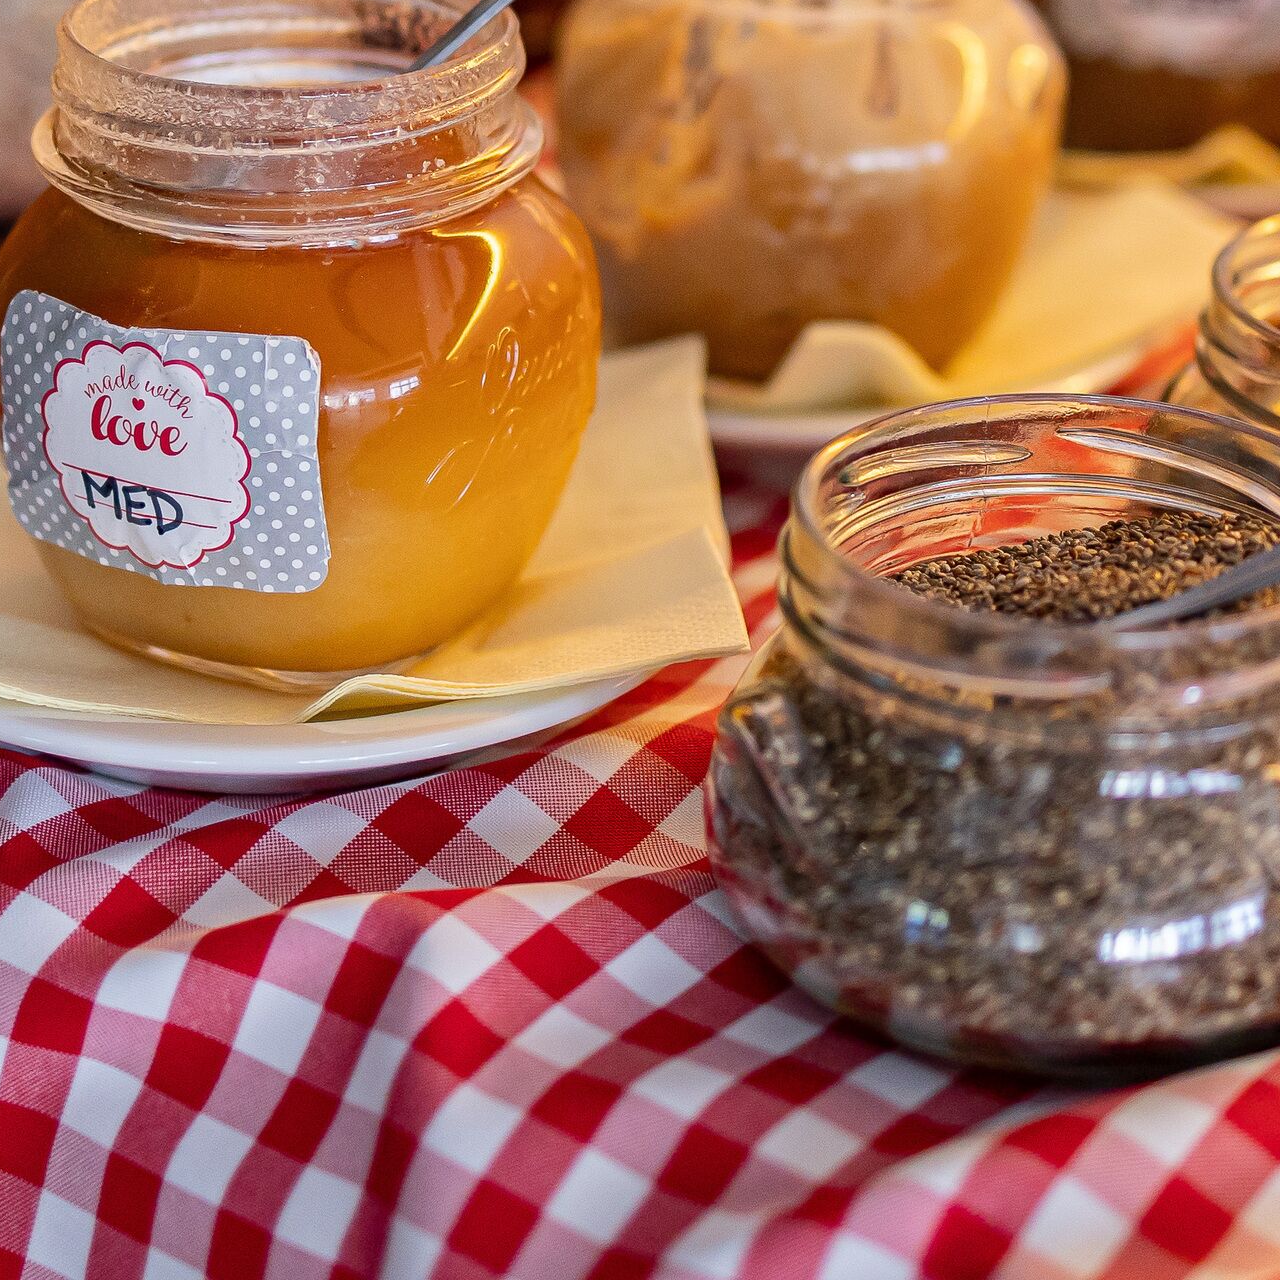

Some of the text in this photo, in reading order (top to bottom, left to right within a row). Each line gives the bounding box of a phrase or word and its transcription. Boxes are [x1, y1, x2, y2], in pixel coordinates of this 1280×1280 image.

[84, 365, 193, 419] made with
[91, 395, 188, 456] love
[81, 470, 184, 535] MED
